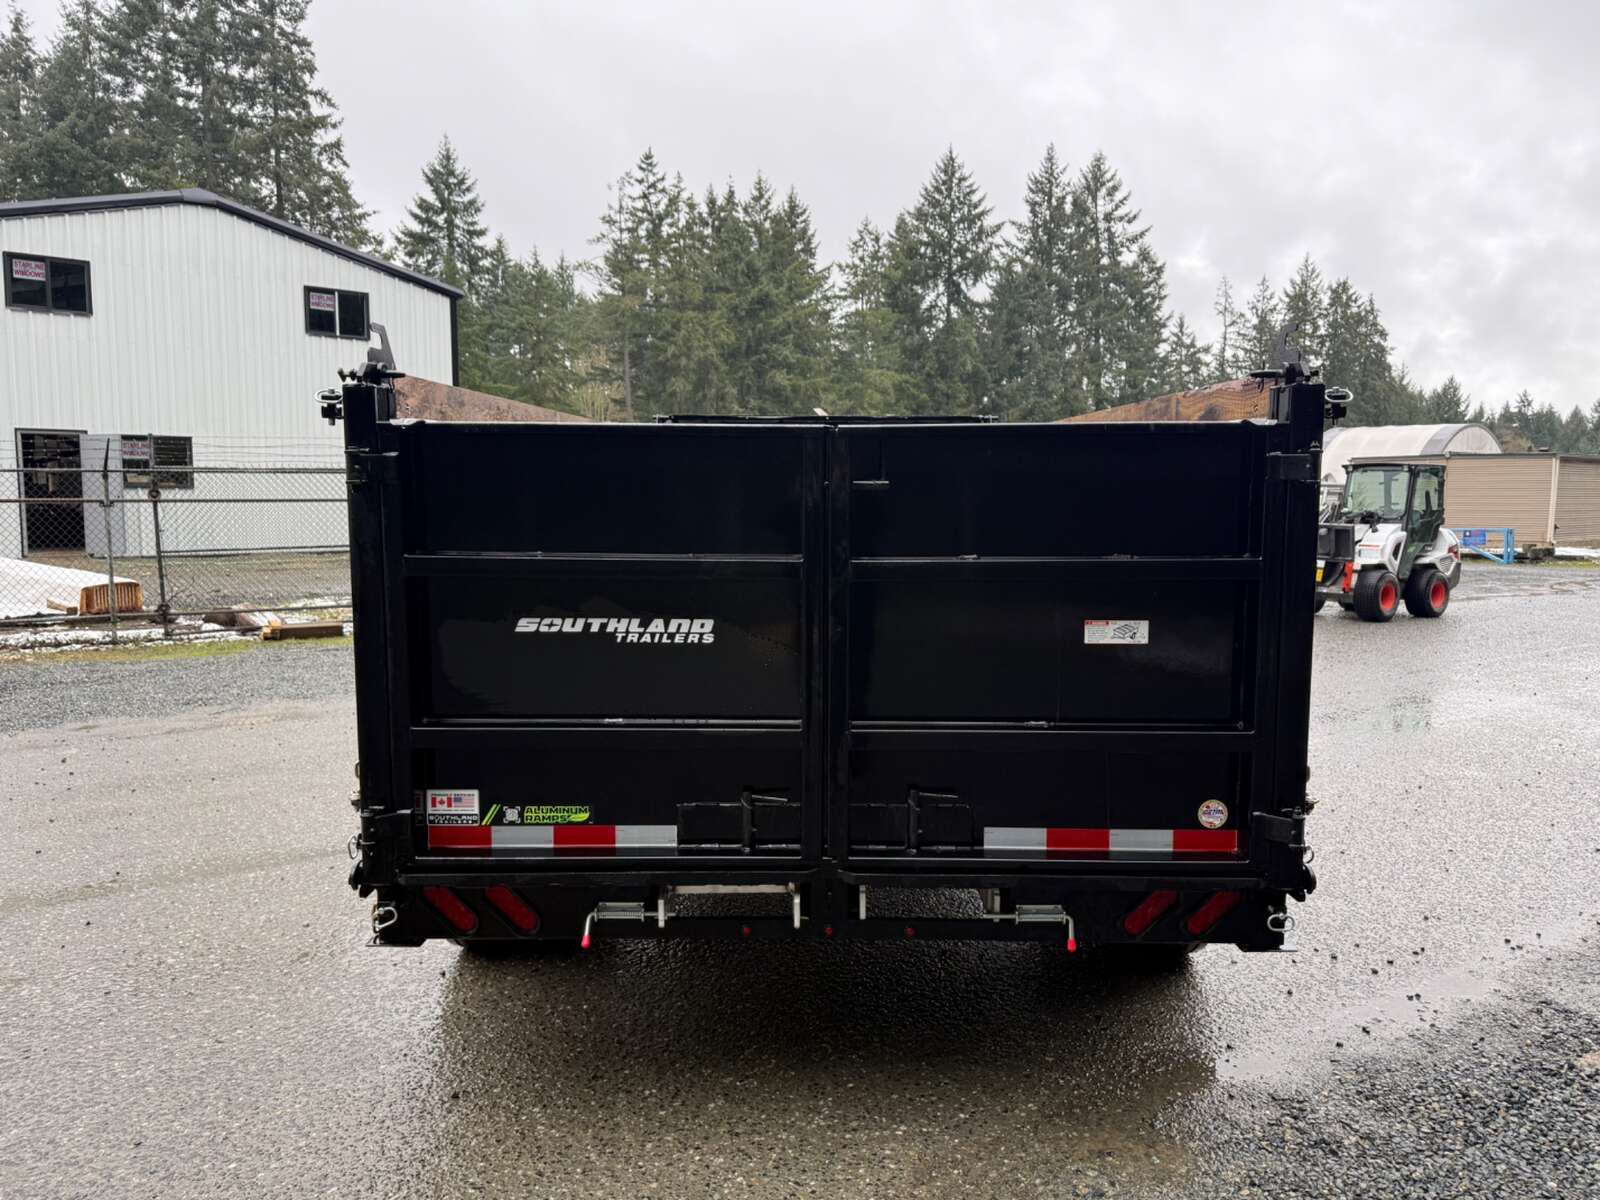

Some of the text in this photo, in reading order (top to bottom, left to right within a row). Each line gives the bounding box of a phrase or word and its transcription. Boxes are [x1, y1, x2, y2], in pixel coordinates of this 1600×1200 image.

[514, 617, 714, 633] SOUTHLAND
[615, 633, 715, 644] TRAILERS
[525, 806, 589, 815] ALUMINUM
[525, 815, 568, 824] RAMPS
